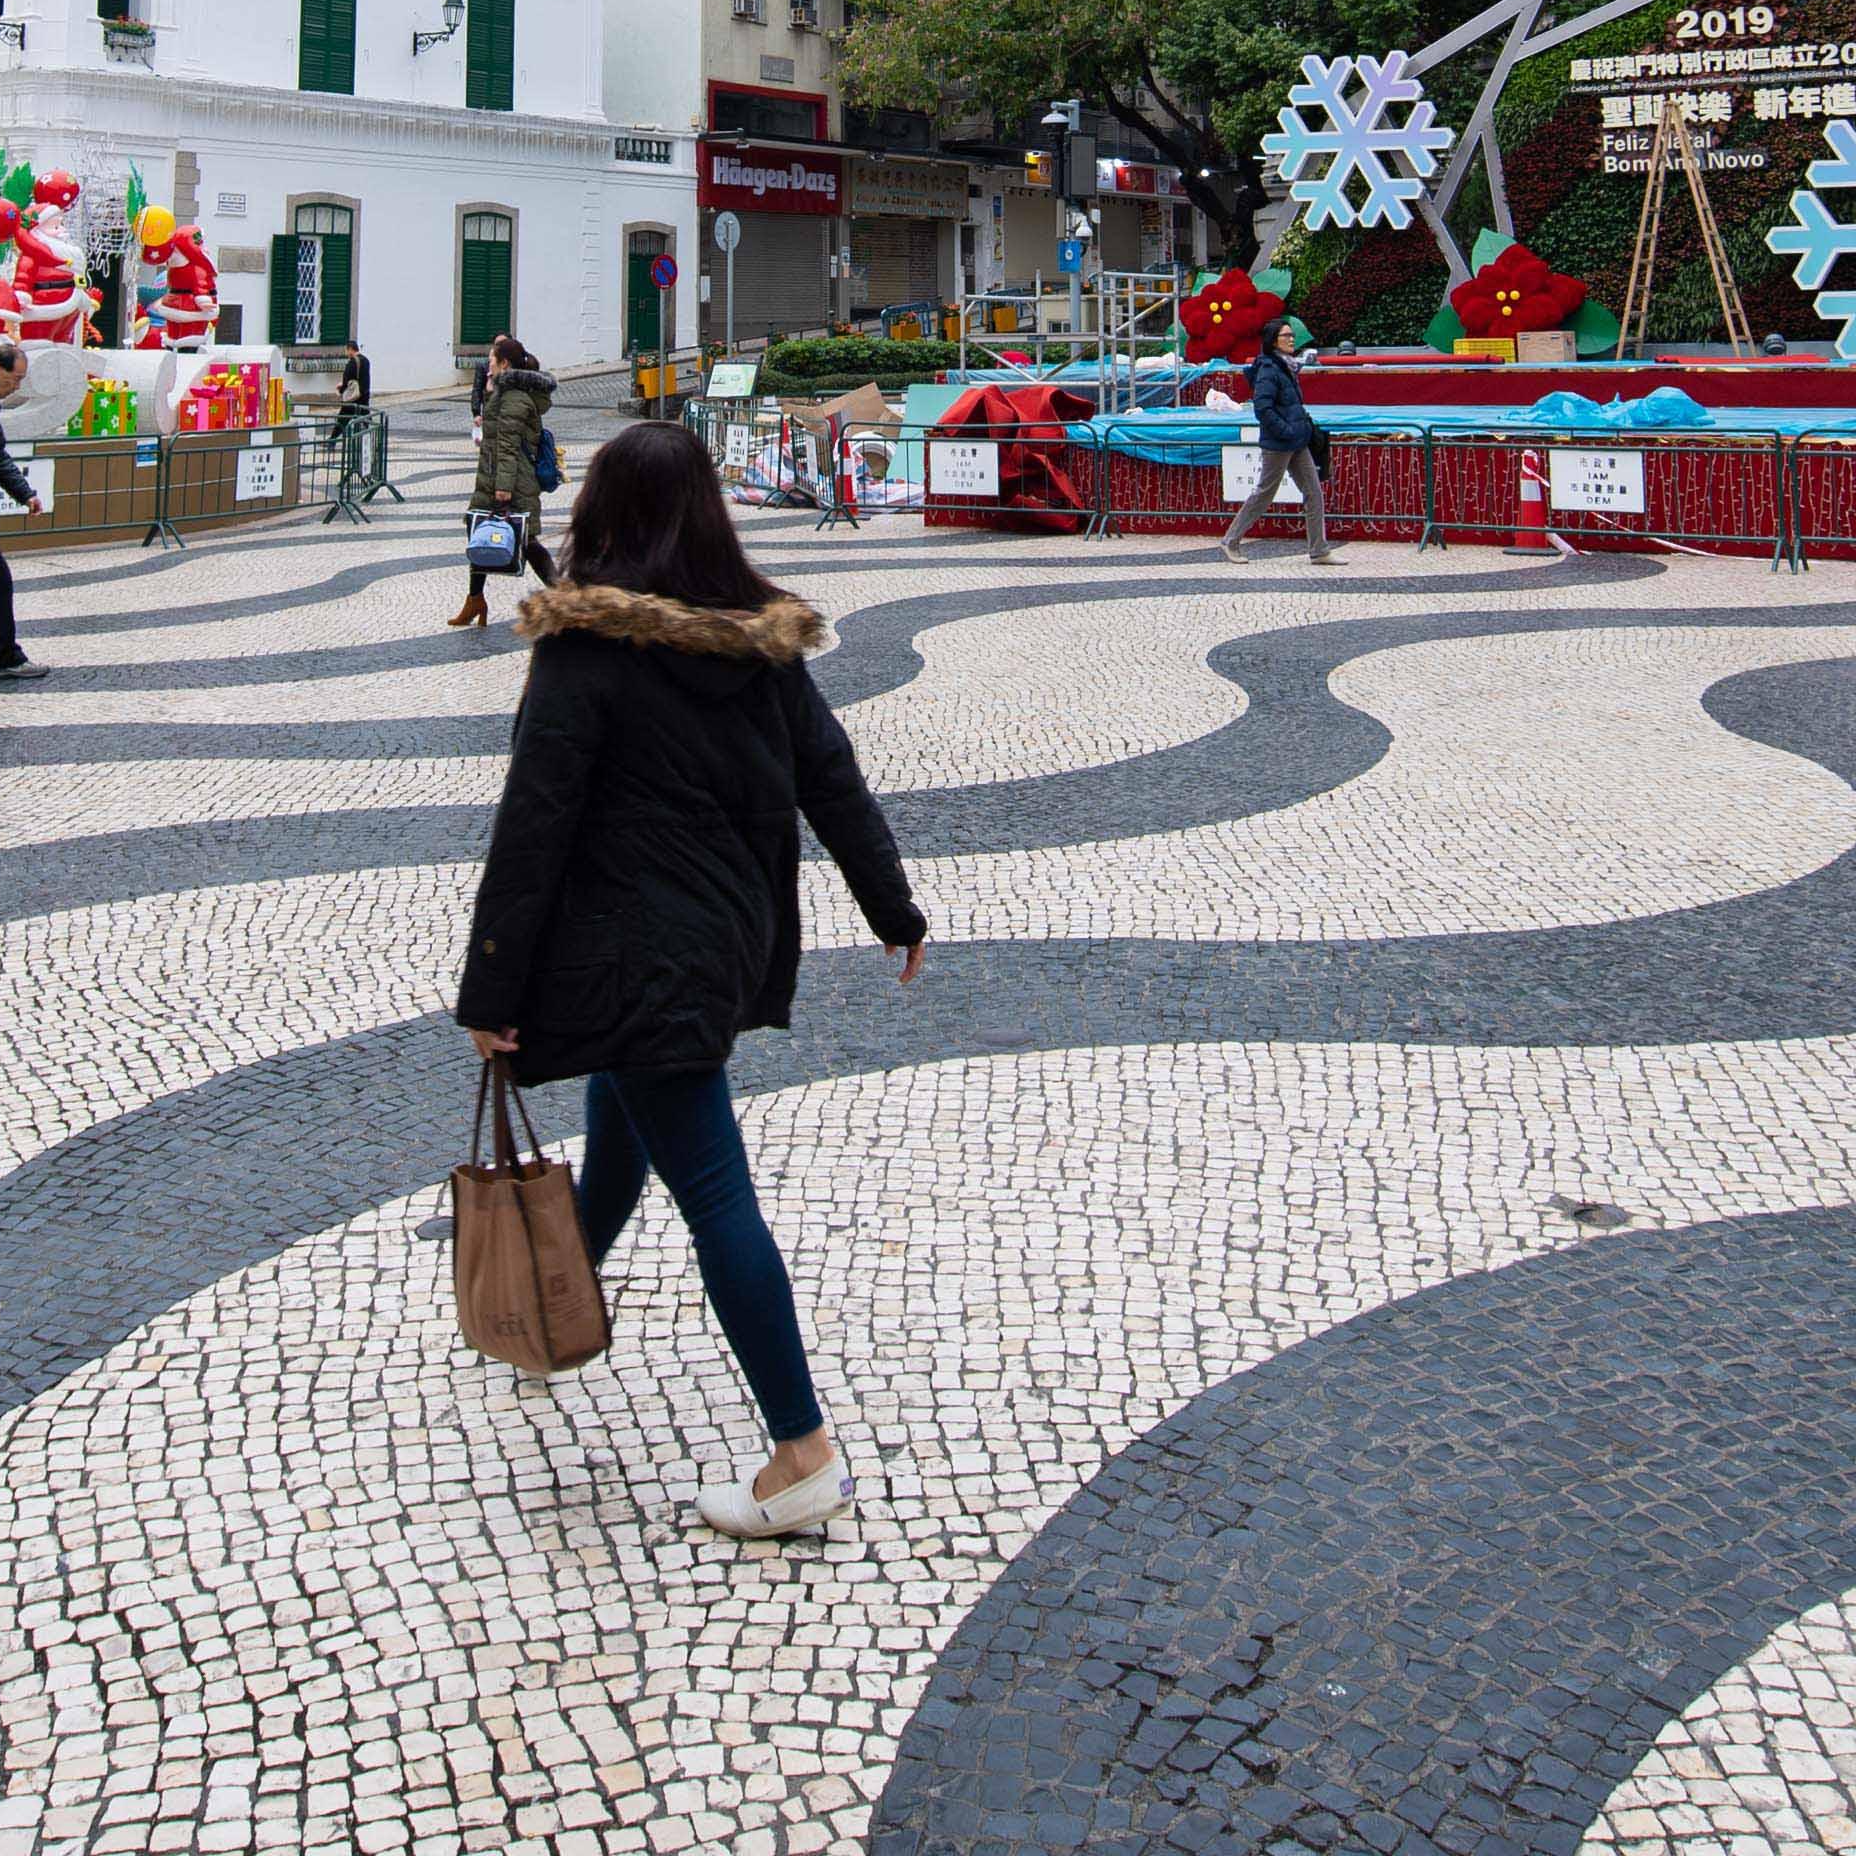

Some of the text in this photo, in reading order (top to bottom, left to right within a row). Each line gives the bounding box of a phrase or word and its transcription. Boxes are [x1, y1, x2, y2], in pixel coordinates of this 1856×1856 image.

[1676, 6, 1774, 39] 2019
[1603, 134, 1650, 152] Feliz
[1604, 155, 1652, 174] Bom
[1708, 151, 1764, 169] Novo
[713, 156, 836, 195] Häagen-Dazs
[1588, 472, 1608, 480] IAM
